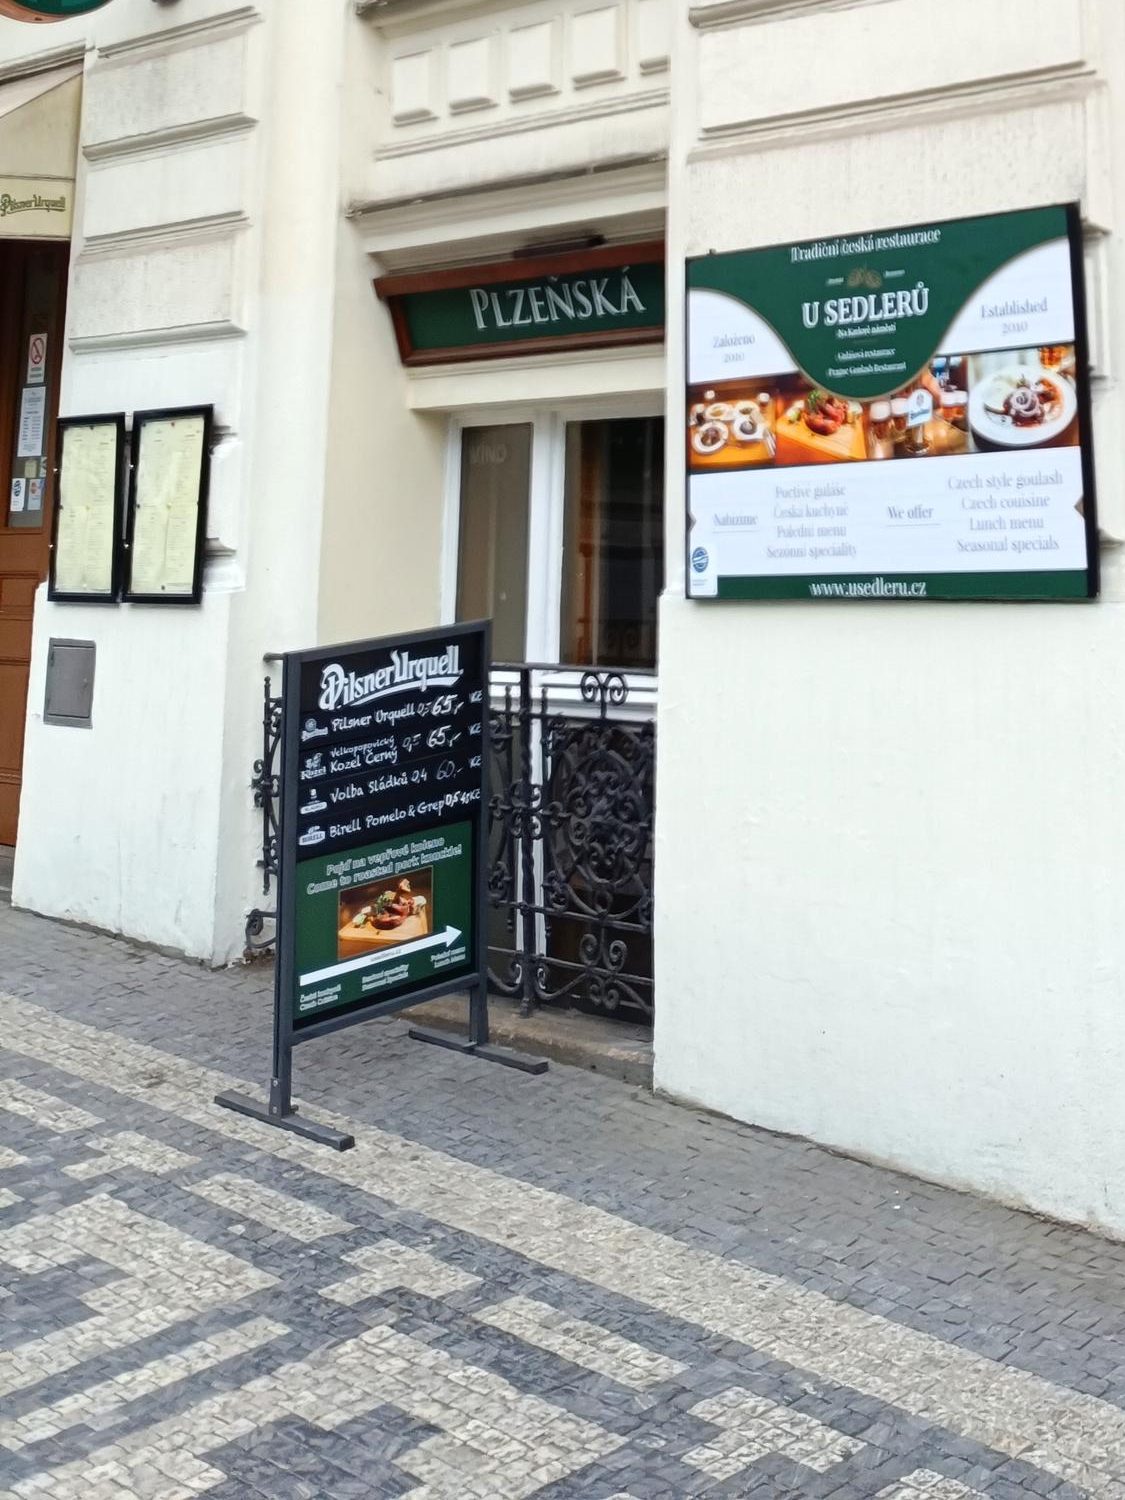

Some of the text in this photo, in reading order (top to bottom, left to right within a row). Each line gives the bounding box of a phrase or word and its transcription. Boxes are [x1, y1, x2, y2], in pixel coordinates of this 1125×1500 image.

[790, 229, 941, 263] Tradiční česká restaurace
[469, 266, 646, 331] PLZEŇSKÁ
[802, 281, 930, 328] U SEDLERŮ
[981, 296, 1048, 318] Established
[948, 468, 1063, 491] Czech style goulash
[887, 504, 934, 519] We offer
[961, 495, 997, 511] Czech
[970, 515, 1044, 531] Lunch menu
[957, 535, 1060, 555] Seasonal specials
[809, 577, 927, 596] www.usedleru.cz
[318, 645, 460, 711] Pilsner Urquell
[332, 714, 373, 732] Pilsner
[375, 703, 415, 726] Urquell
[331, 748, 398, 773] Kozel Černý
[331, 783, 364, 803] Volba
[329, 820, 361, 837] Birell
[366, 808, 407, 829] Pomelo
[417, 800, 445, 817] Grep
